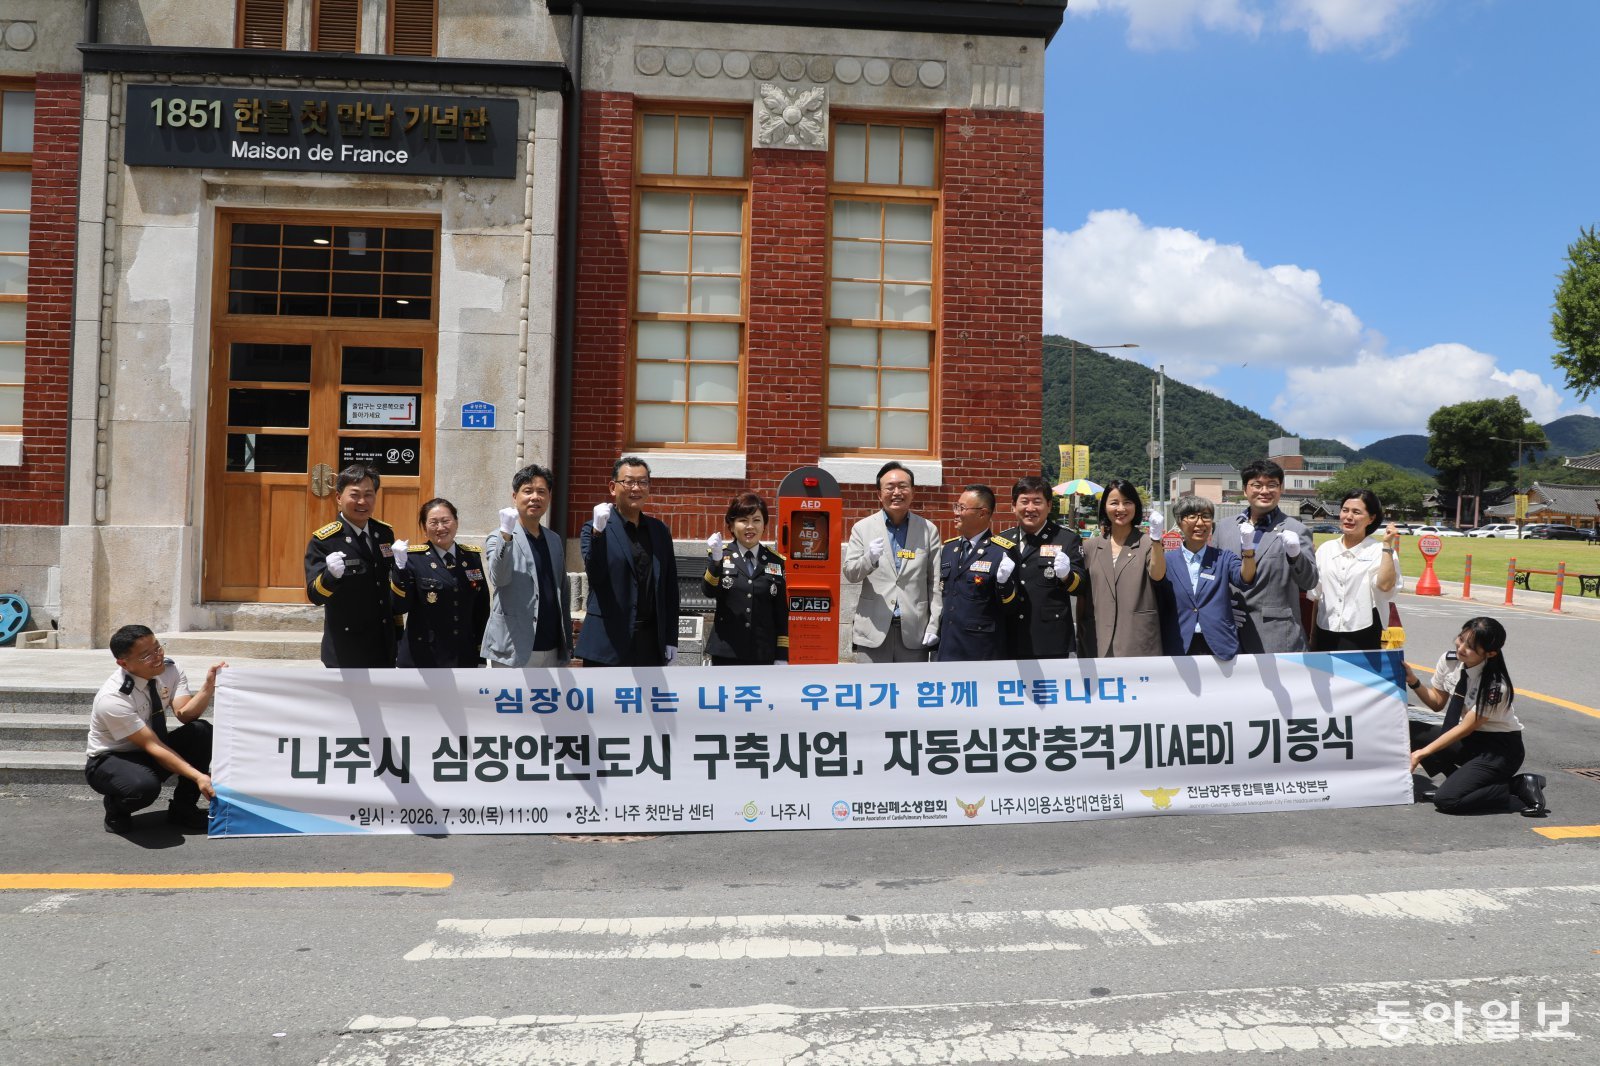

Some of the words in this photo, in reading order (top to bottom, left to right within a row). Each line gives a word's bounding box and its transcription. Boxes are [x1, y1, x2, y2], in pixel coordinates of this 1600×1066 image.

[150, 98, 222, 129] 1851
[233, 98, 292, 134] 한불
[300, 101, 329, 135] 첫
[337, 101, 395, 138] 만남
[404, 104, 489, 142] 기념관
[231, 141, 300, 161] Maison
[308, 144, 334, 162] de
[341, 145, 409, 164] France
[468, 415, 487, 425] 1-1
[800, 500, 821, 508] AED
[799, 530, 819, 539] AED
[805, 600, 830, 610] AED
[614, 686, 680, 714] 뛰는
[699, 685, 775, 713] 나주,
[800, 683, 900, 711] 우리가
[917, 680, 978, 708] 함께
[431, 732, 672, 782] 심장안전도시
[884, 721, 1235, 777] 자동심장충격기[AED]
[1248, 715, 1355, 765] 기증식
[1186, 779, 1329, 799] 전남광주통합특별시소방본부
[614, 804, 642, 823] 나주
[645, 804, 685, 823] 첫만남
[688, 803, 715, 822] 센터
[771, 802, 810, 821] 나주시
[851, 799, 948, 815] 대한심폐소생협회
[991, 793, 1124, 816] 나주시의용소방대연합회
[400, 808, 438, 825] 2026.
[443, 808, 456, 825] 7.
[459, 805, 505, 826] 30.(목)
[509, 807, 549, 824] 11:00
